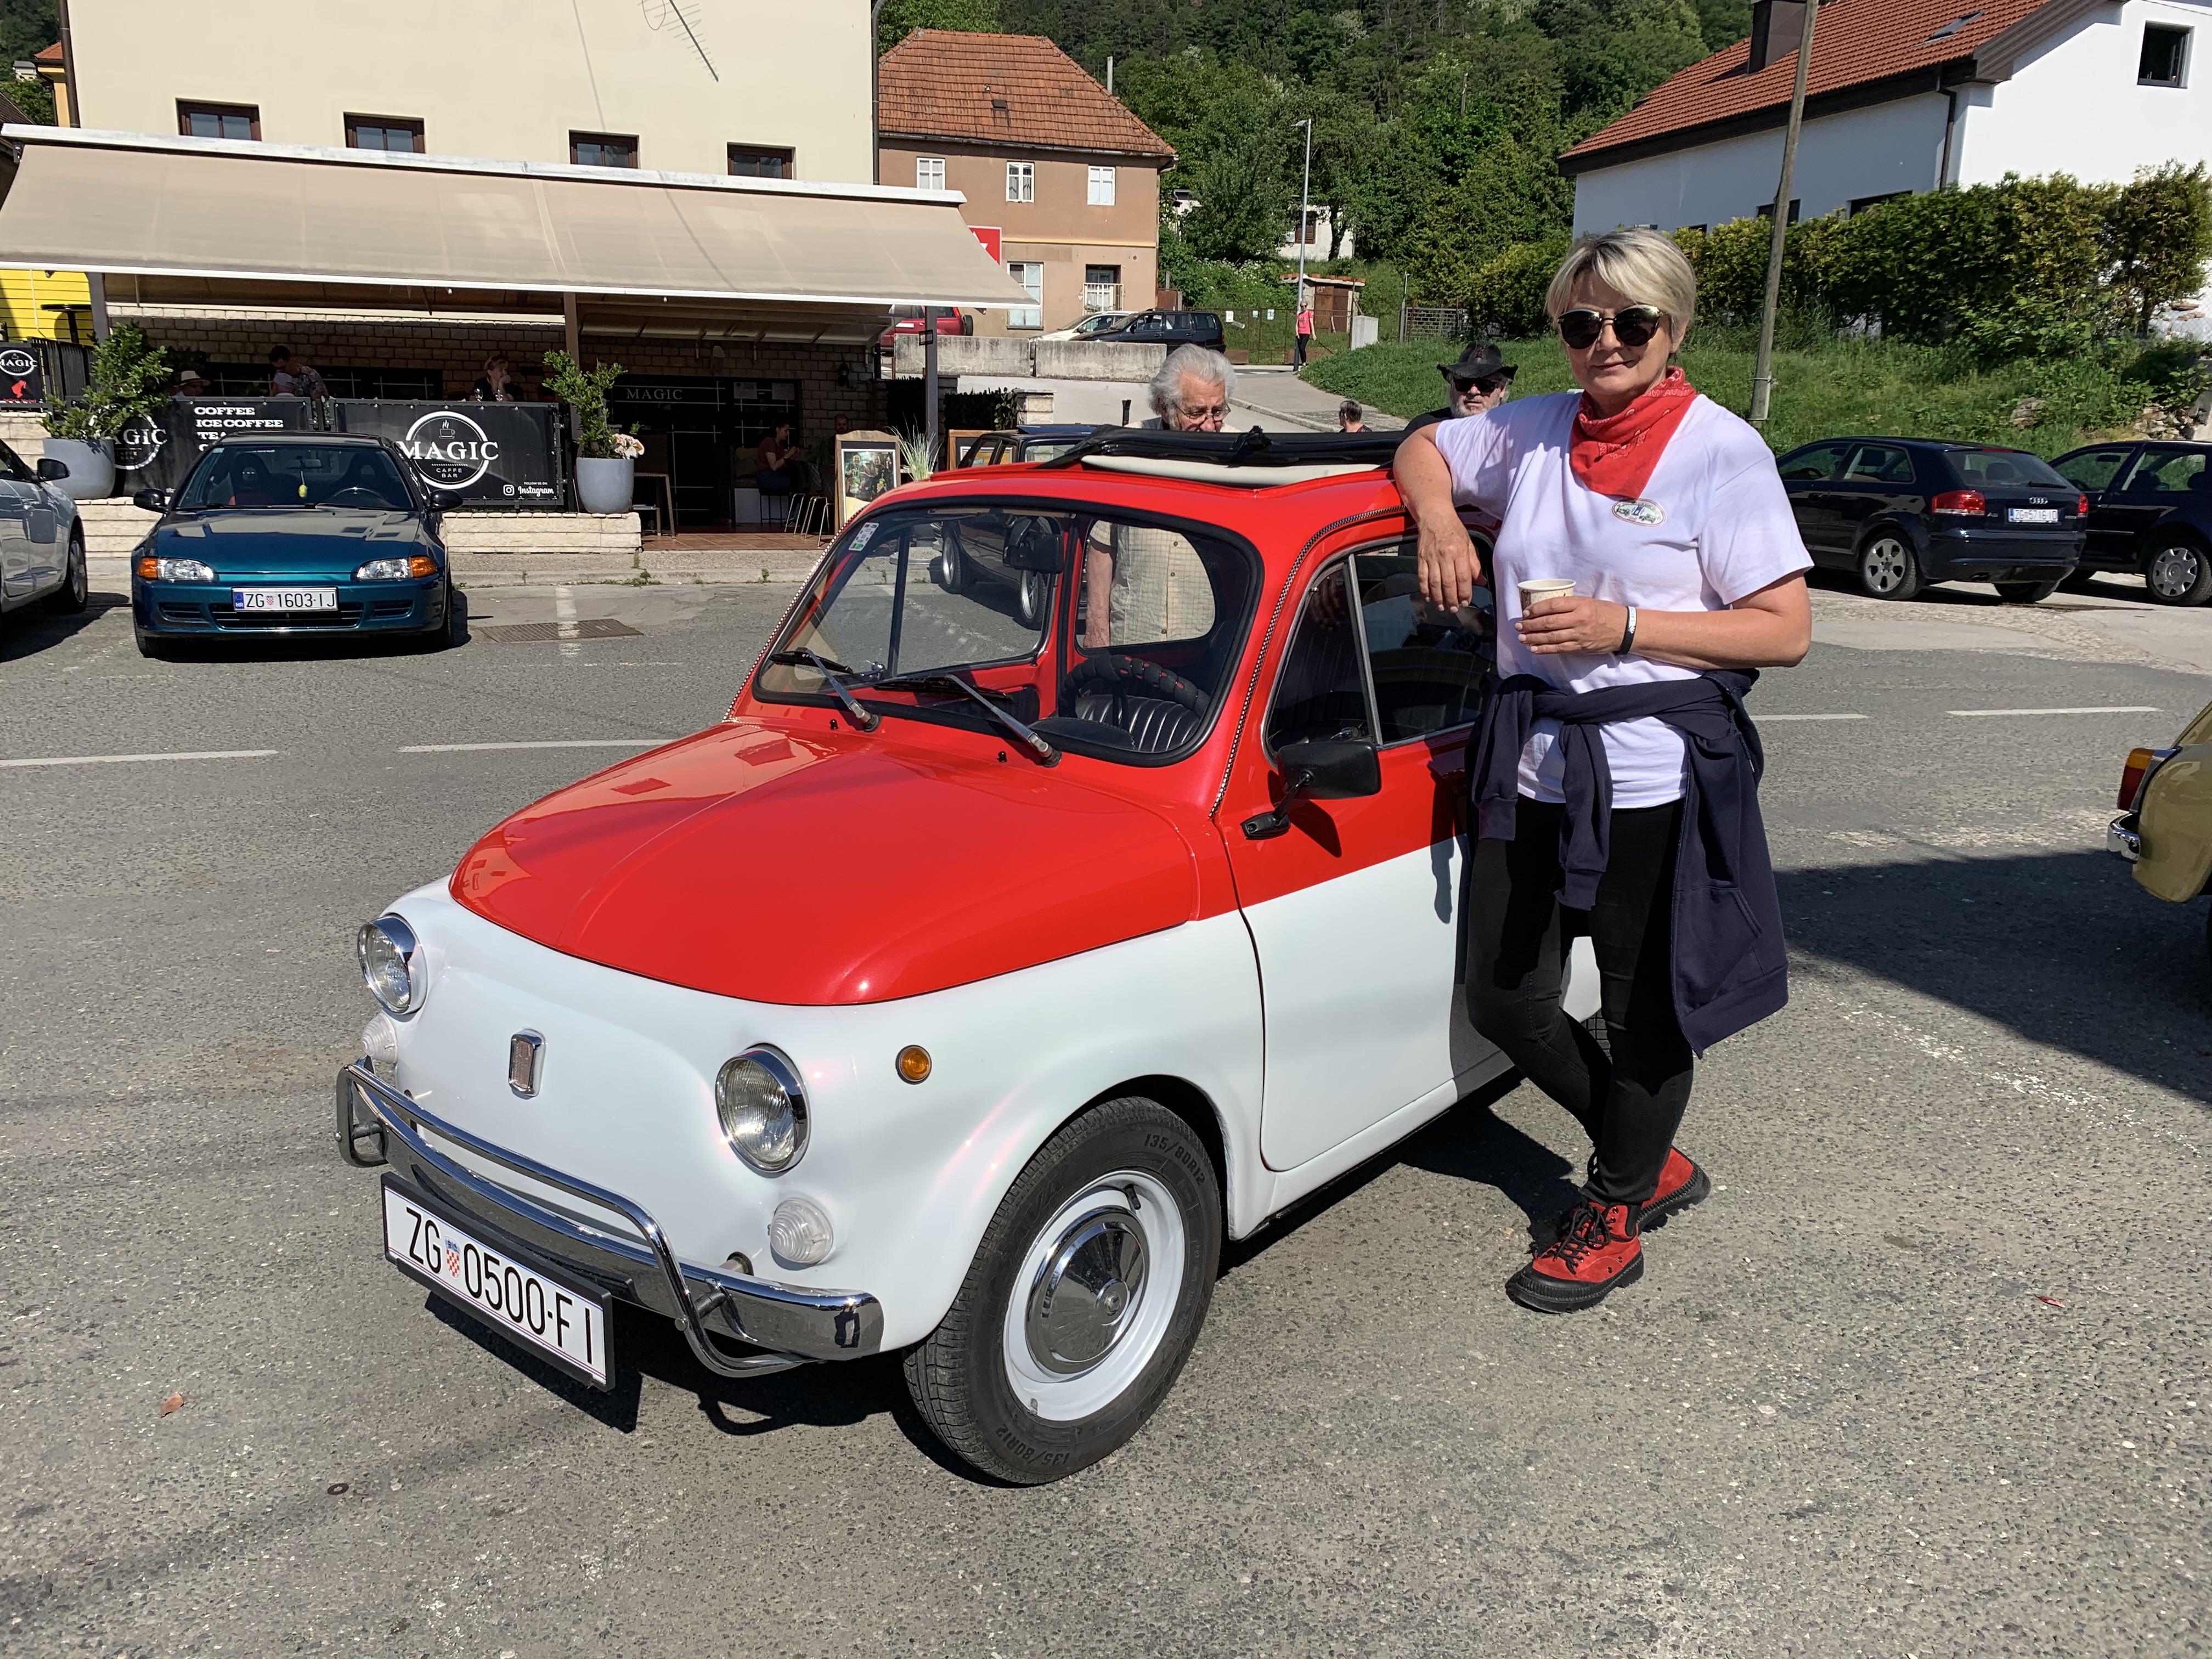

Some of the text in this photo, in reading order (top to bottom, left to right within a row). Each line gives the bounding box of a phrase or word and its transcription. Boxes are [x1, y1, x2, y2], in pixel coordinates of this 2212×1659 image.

[625, 388, 682, 400] MAGIC
[194, 407, 255, 415] COFFEE
[195, 419, 284, 427] ICE COFFEE
[396, 441, 499, 460] MAGIC
[517, 486, 555, 498] Instagram
[2015, 510, 2024, 520] ZG
[245, 593, 265, 608] ZG
[1144, 1133, 1206, 1186] 135/80R12
[406, 1206, 442, 1274] ZG
[995, 1423, 1070, 1465] 135/80R12
